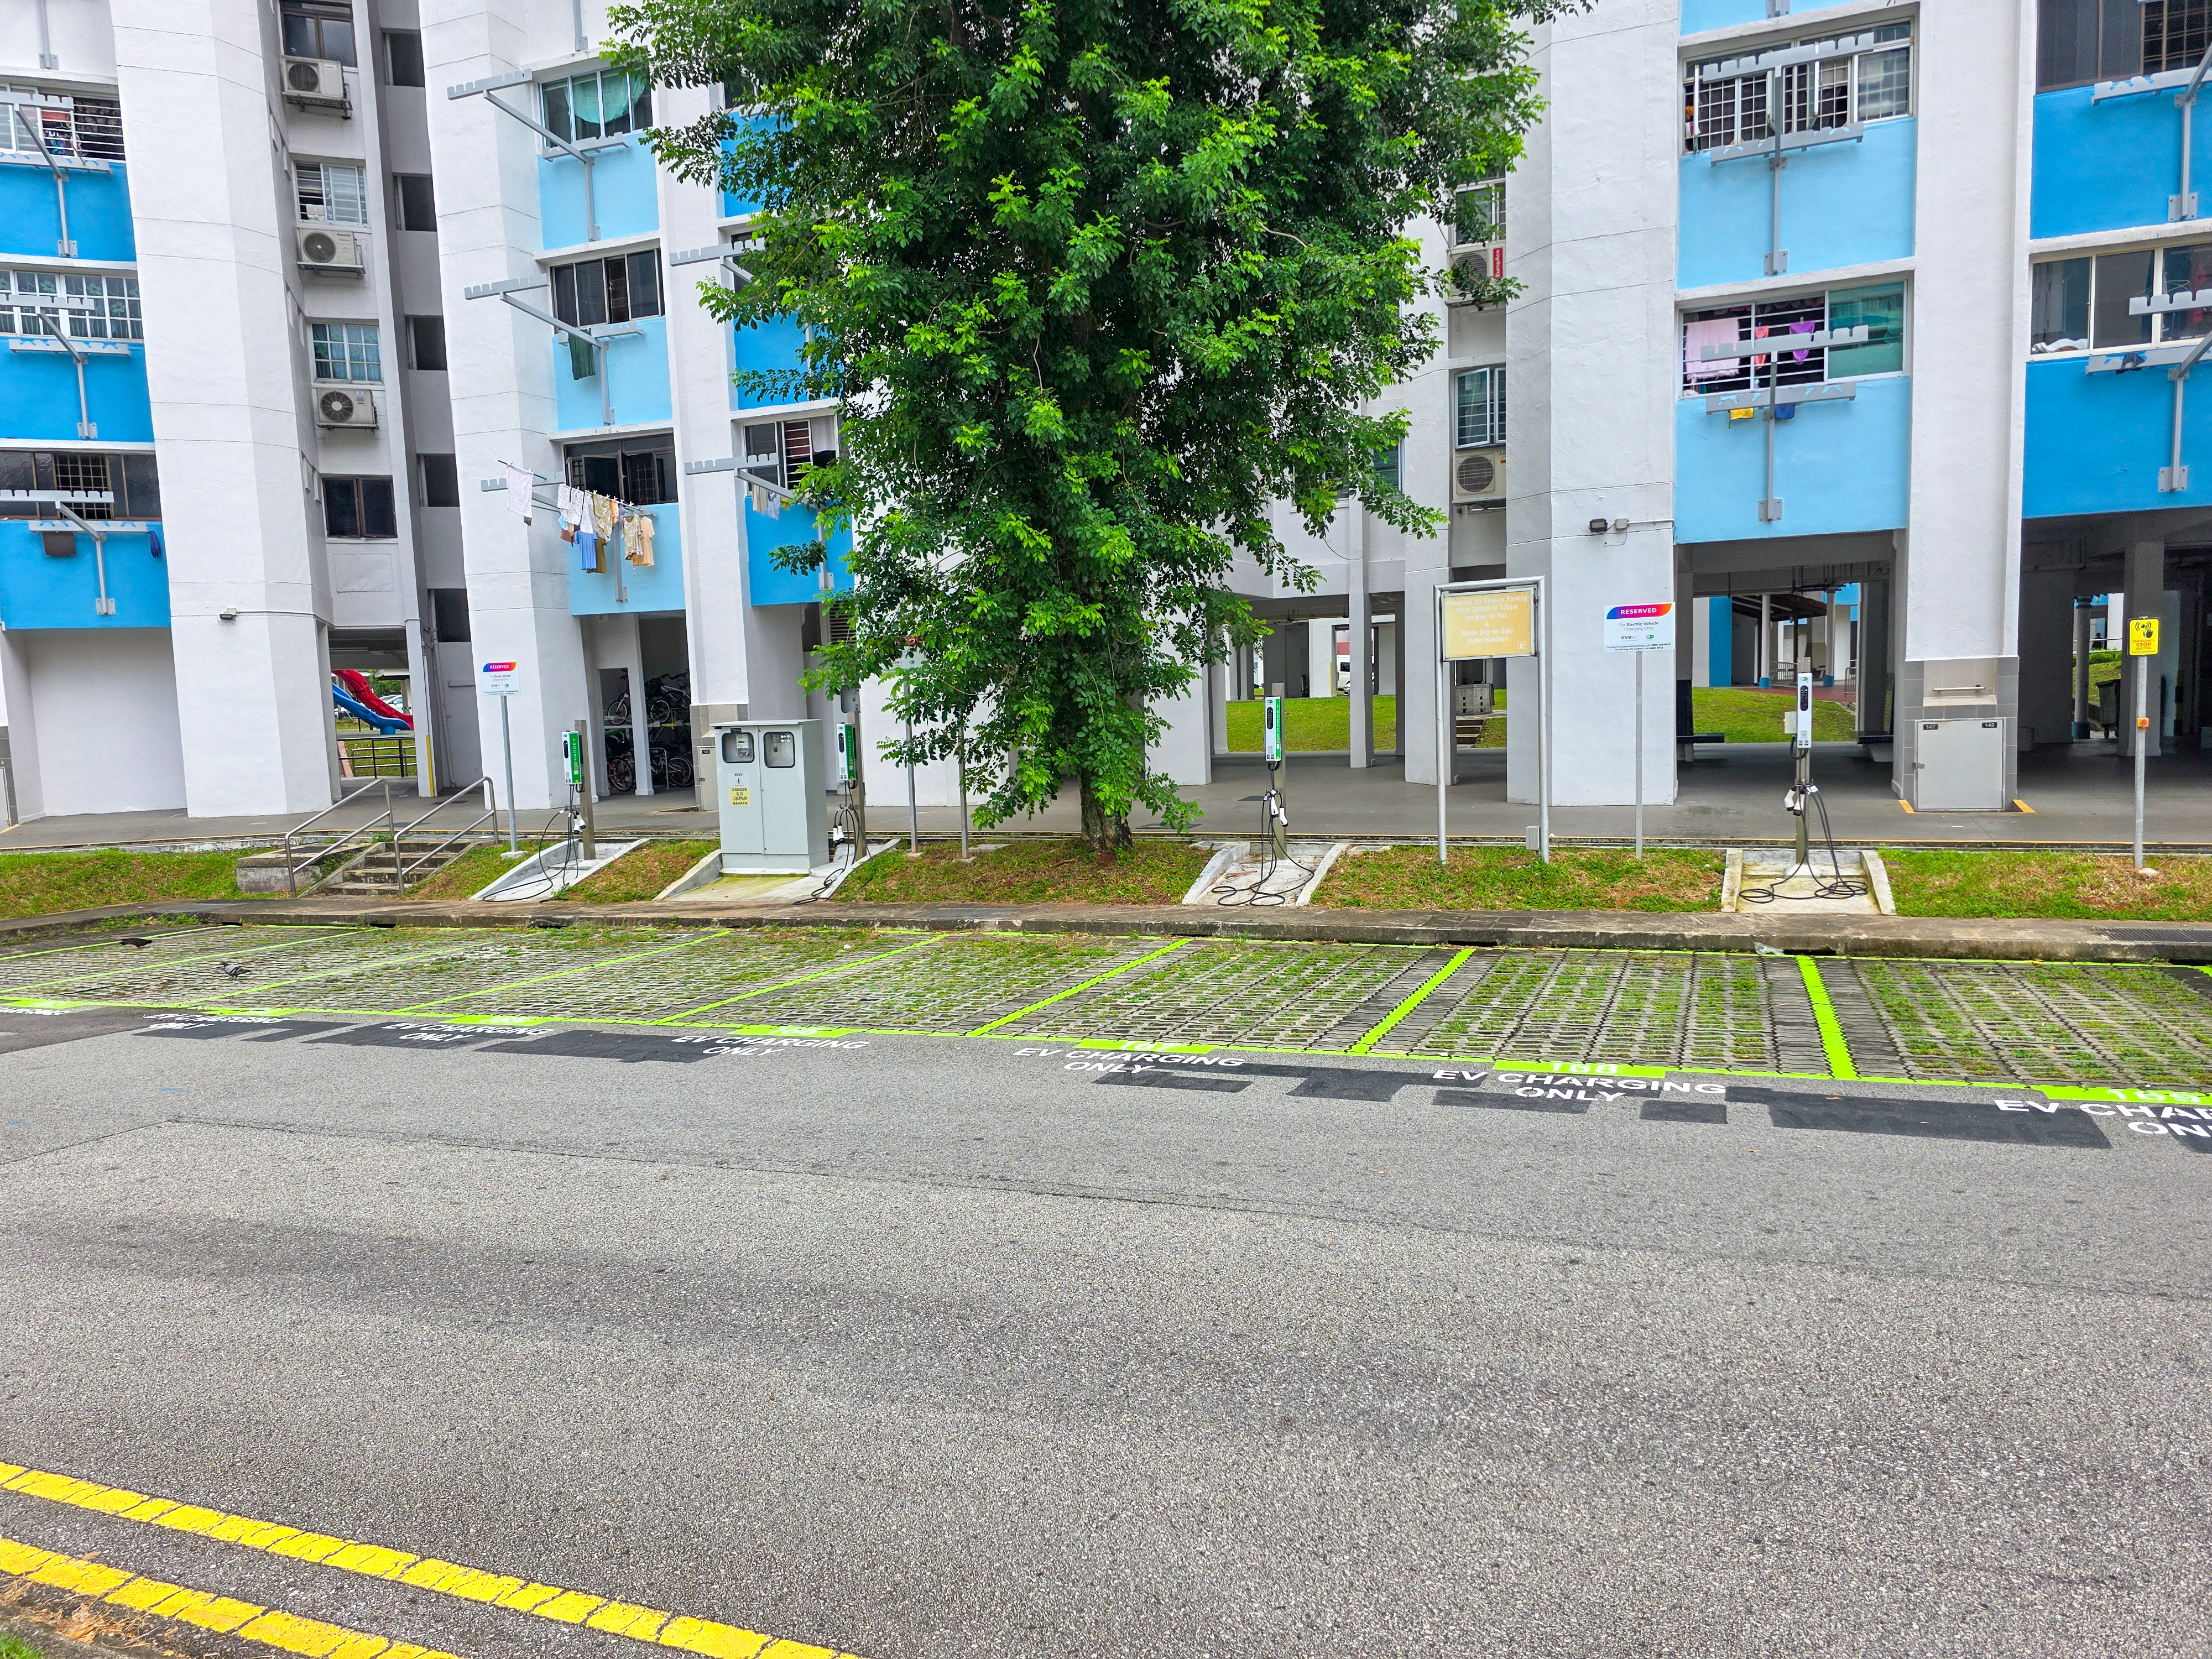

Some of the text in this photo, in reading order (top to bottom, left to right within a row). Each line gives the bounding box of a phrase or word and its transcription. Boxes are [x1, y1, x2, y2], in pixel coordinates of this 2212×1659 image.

[420, 1025, 554, 1035] CHARGING
[399, 1032, 473, 1041] ONLY
[715, 1036, 870, 1048] CHARGING
[702, 1046, 785, 1056] ONLY
[1119, 1041, 1180, 1050] 167
[1012, 1047, 1245, 1066] EV CHARGING
[1063, 1061, 1156, 1073] ONLY
[1551, 1062, 1619, 1074] 168
[1432, 1070, 1726, 1094] EV CHARGING
[1515, 1087, 1626, 1102] ONLY
[1994, 1099, 2060, 1113] EV
[2128, 1121, 2212, 1138] ON
